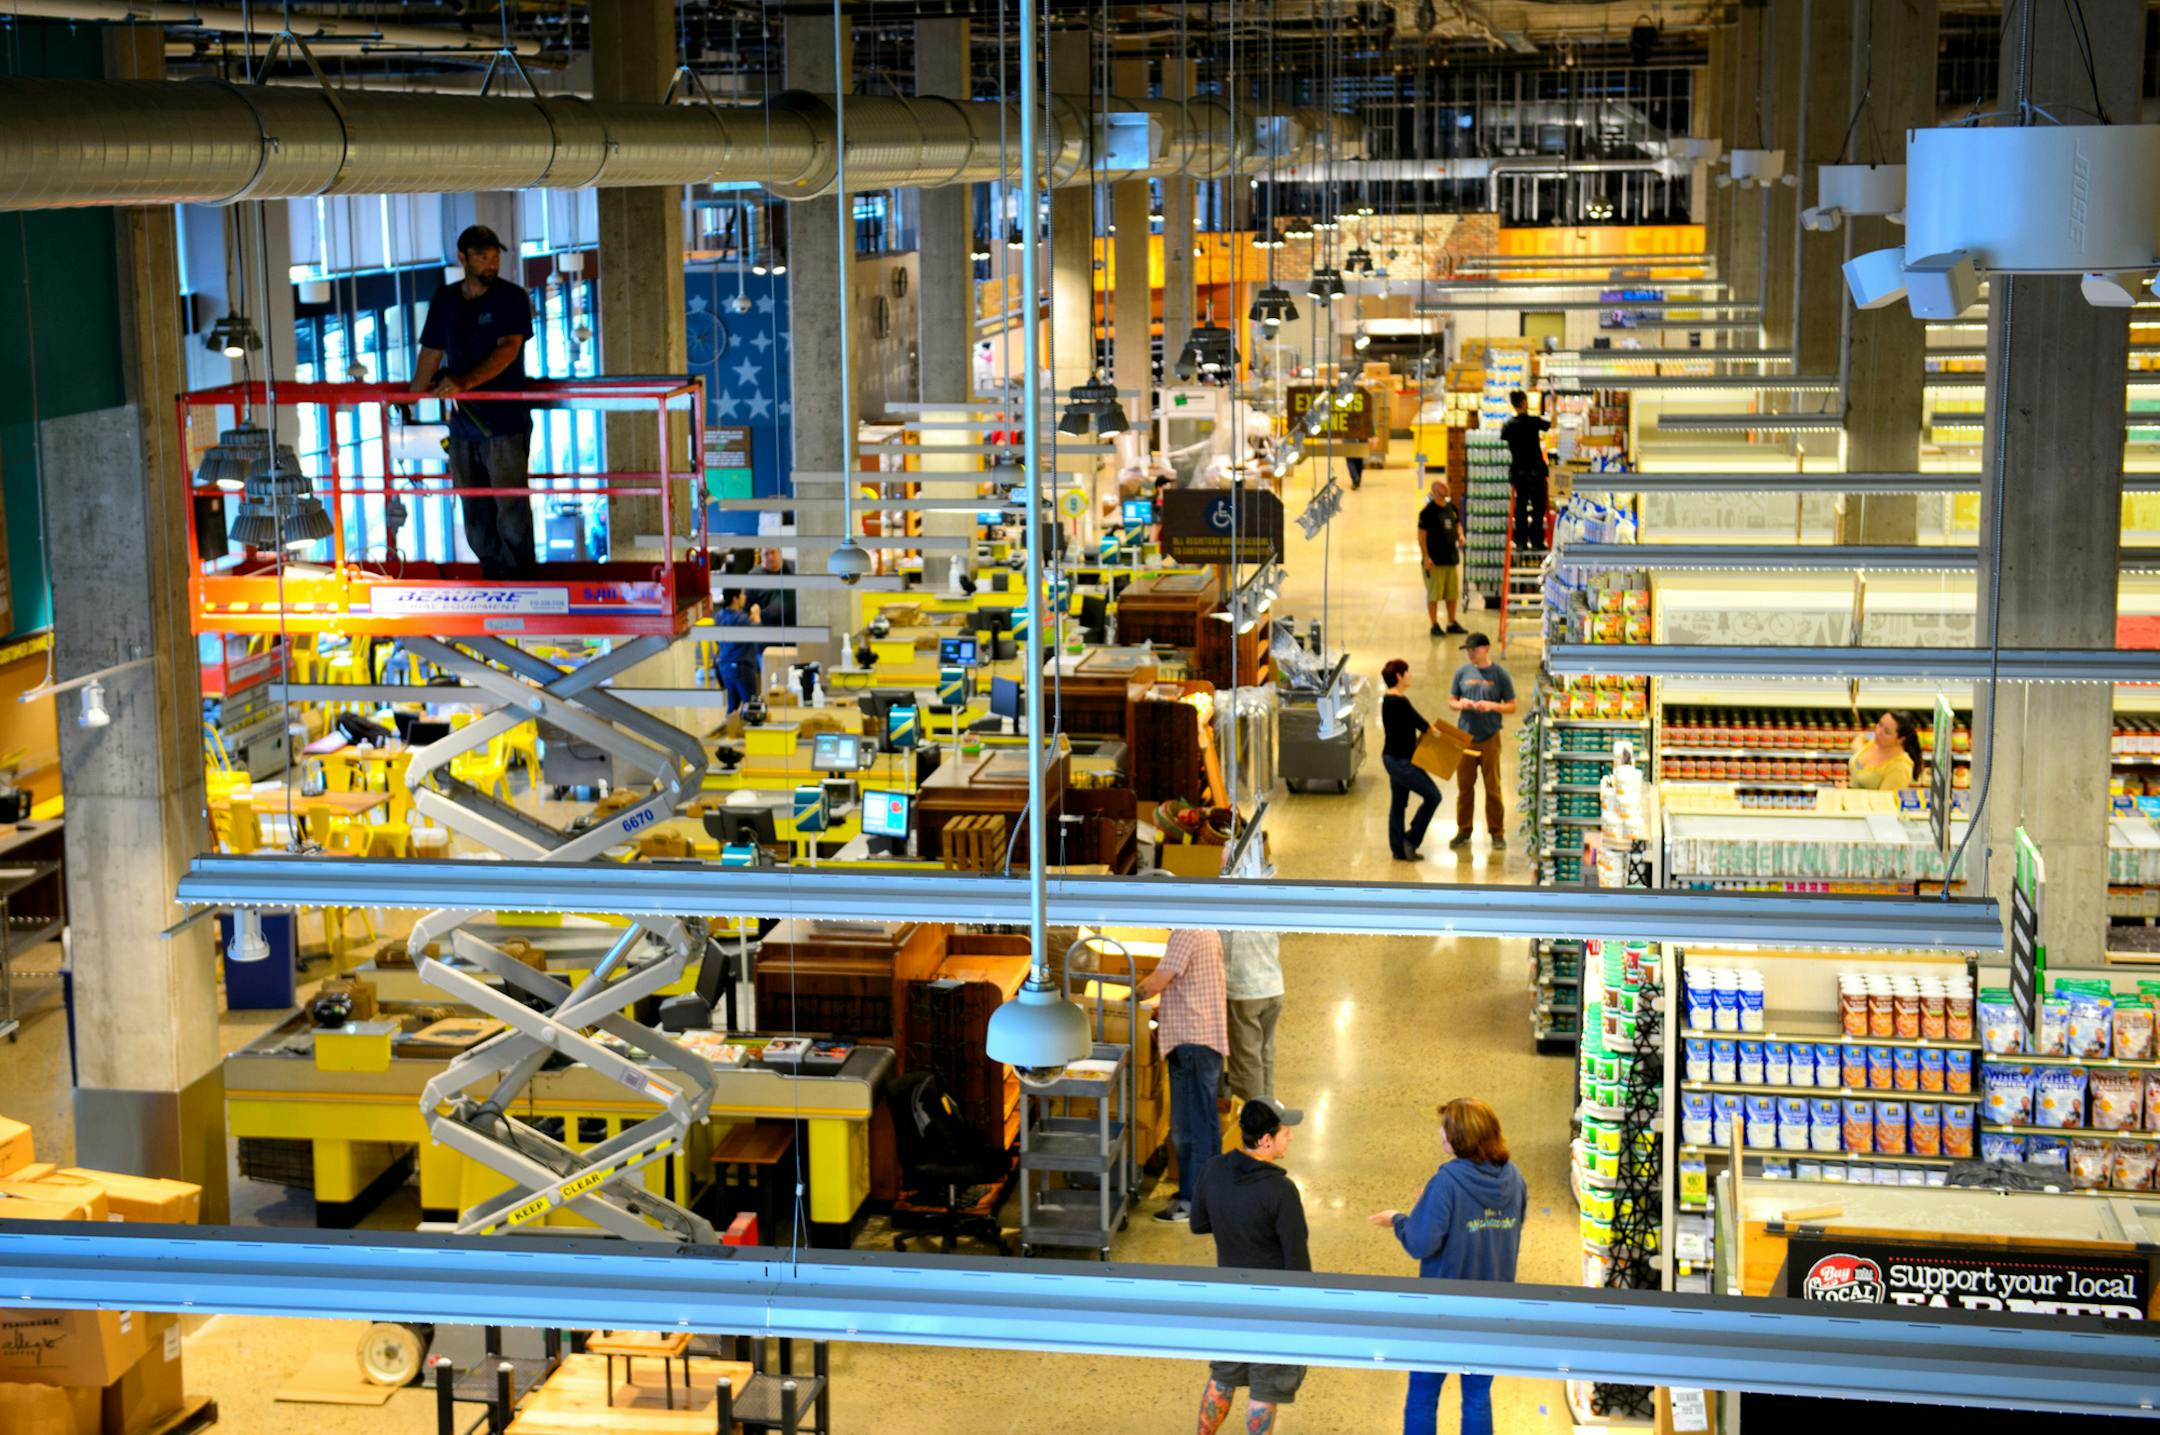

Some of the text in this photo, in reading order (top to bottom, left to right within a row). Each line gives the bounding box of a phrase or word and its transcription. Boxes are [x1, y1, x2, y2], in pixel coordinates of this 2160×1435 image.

[622, 808, 654, 832] 6670
[514, 1174, 601, 1220] KEEP CLEAR
[1820, 1265, 1851, 1282] Buy
[1889, 1264, 1997, 1295] support
[1998, 1273, 2062, 1298] your
[2067, 1271, 2137, 1299] local
[1814, 1284, 1875, 1303] LOCAL
